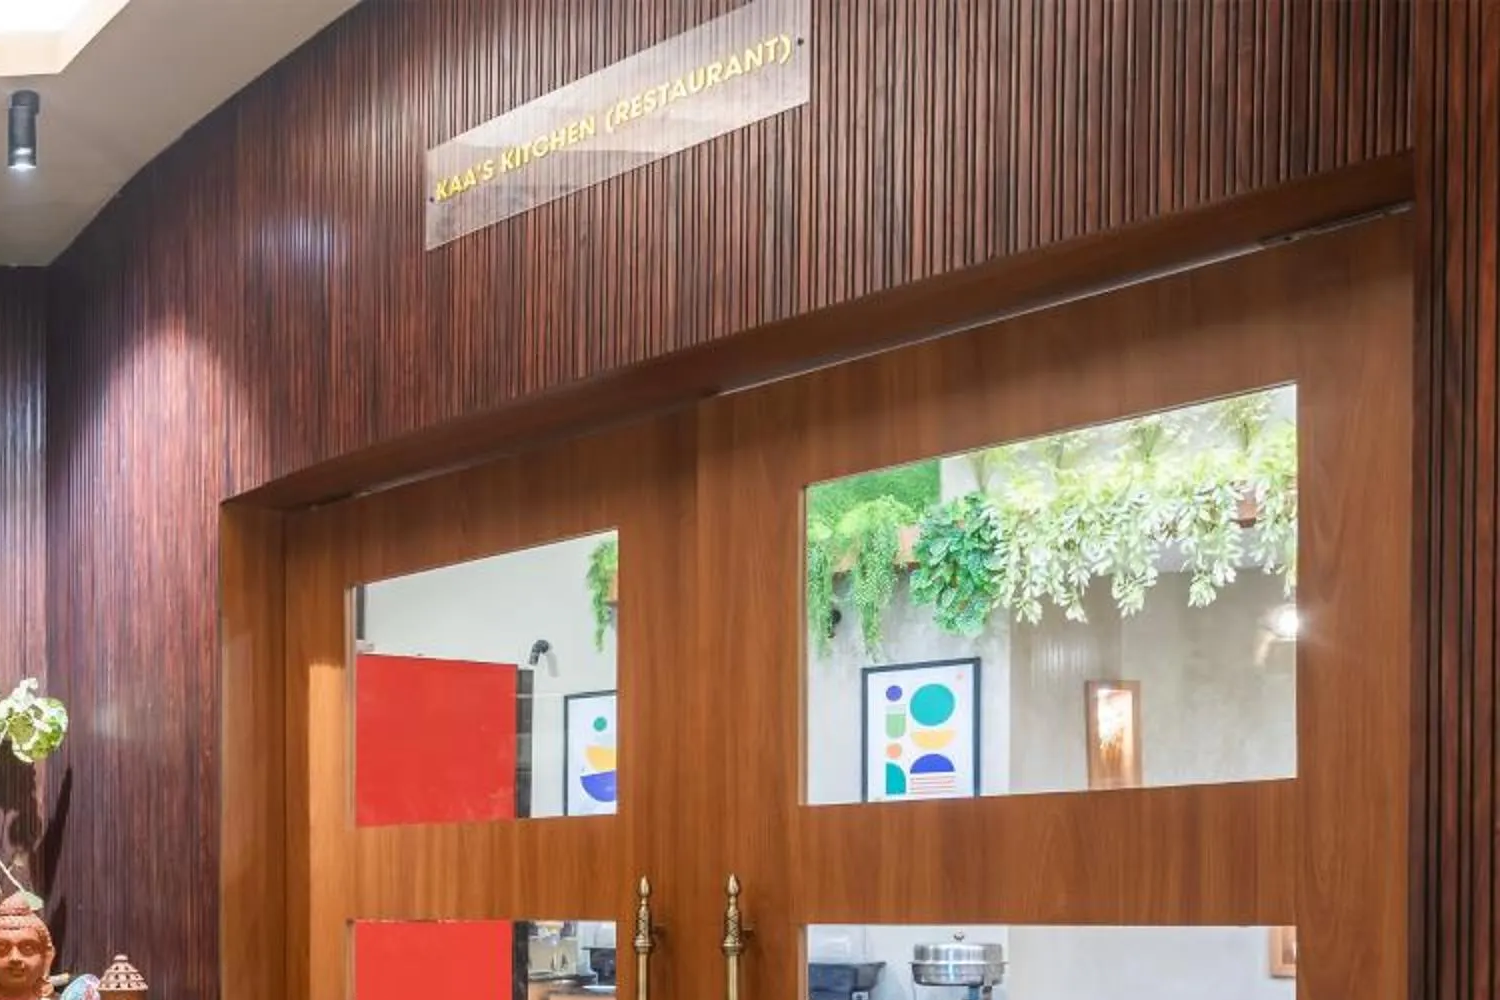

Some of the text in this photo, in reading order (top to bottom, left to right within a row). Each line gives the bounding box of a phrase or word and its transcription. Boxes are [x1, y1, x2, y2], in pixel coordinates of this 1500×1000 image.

[435, 35, 792, 200] KAA'S KITCHEN (RESTAURANT)
